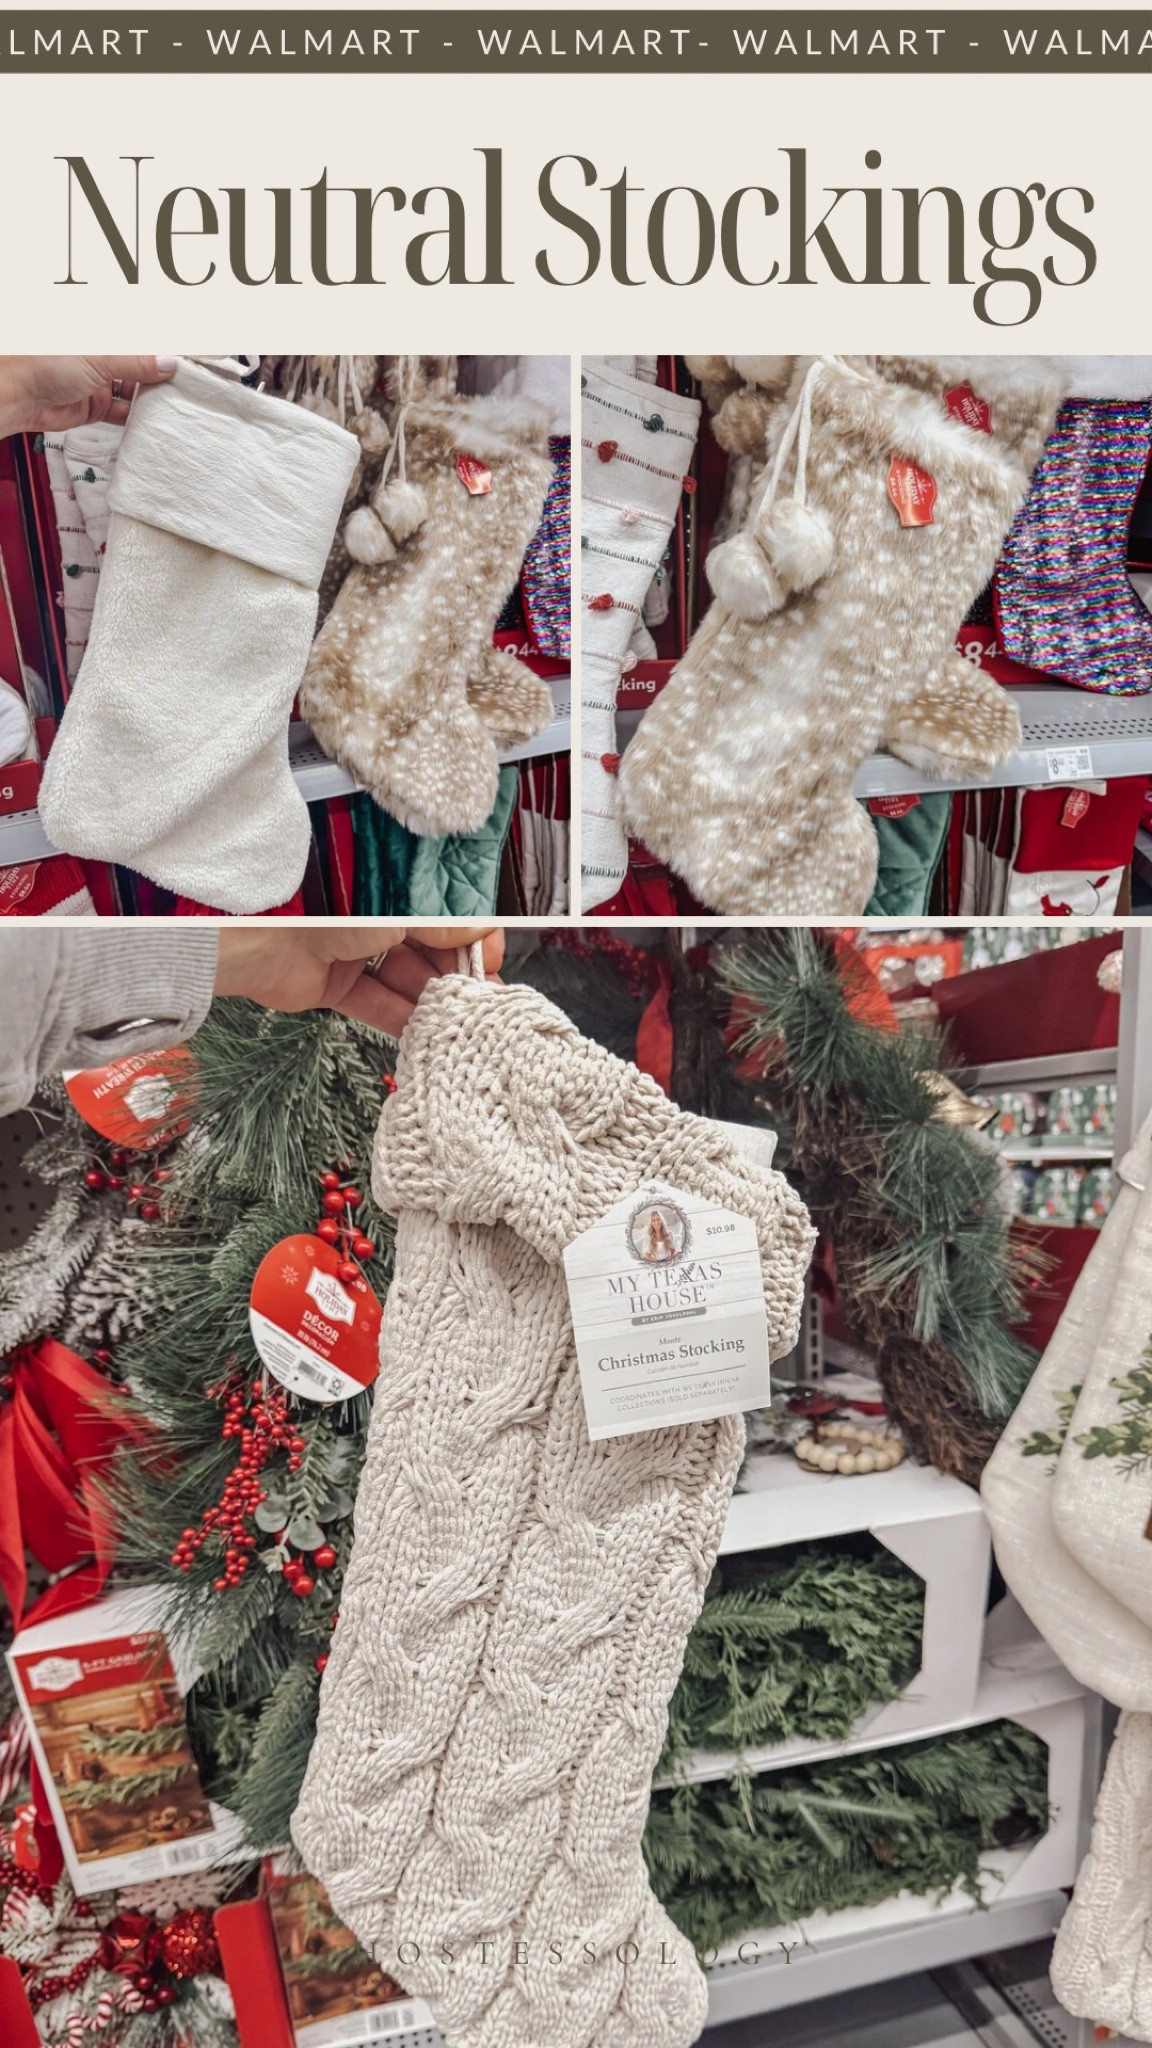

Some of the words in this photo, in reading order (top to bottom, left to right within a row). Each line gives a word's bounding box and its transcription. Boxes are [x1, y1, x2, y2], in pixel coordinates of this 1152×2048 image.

[618, 678, 656, 692] king
[706, 1224, 735, 1235] $10.98
[608, 1274, 640, 1296] MY
[647, 1261, 722, 1289] TEXAS
[303, 1309, 339, 1341] DÉCOR
[597, 1349, 675, 1371] Christmas
[679, 1338, 745, 1358] Stocking
[610, 1390, 660, 1404] COORDINATES
[662, 1387, 680, 1395] WITH
[617, 1397, 664, 1411] COLLECTIONS
